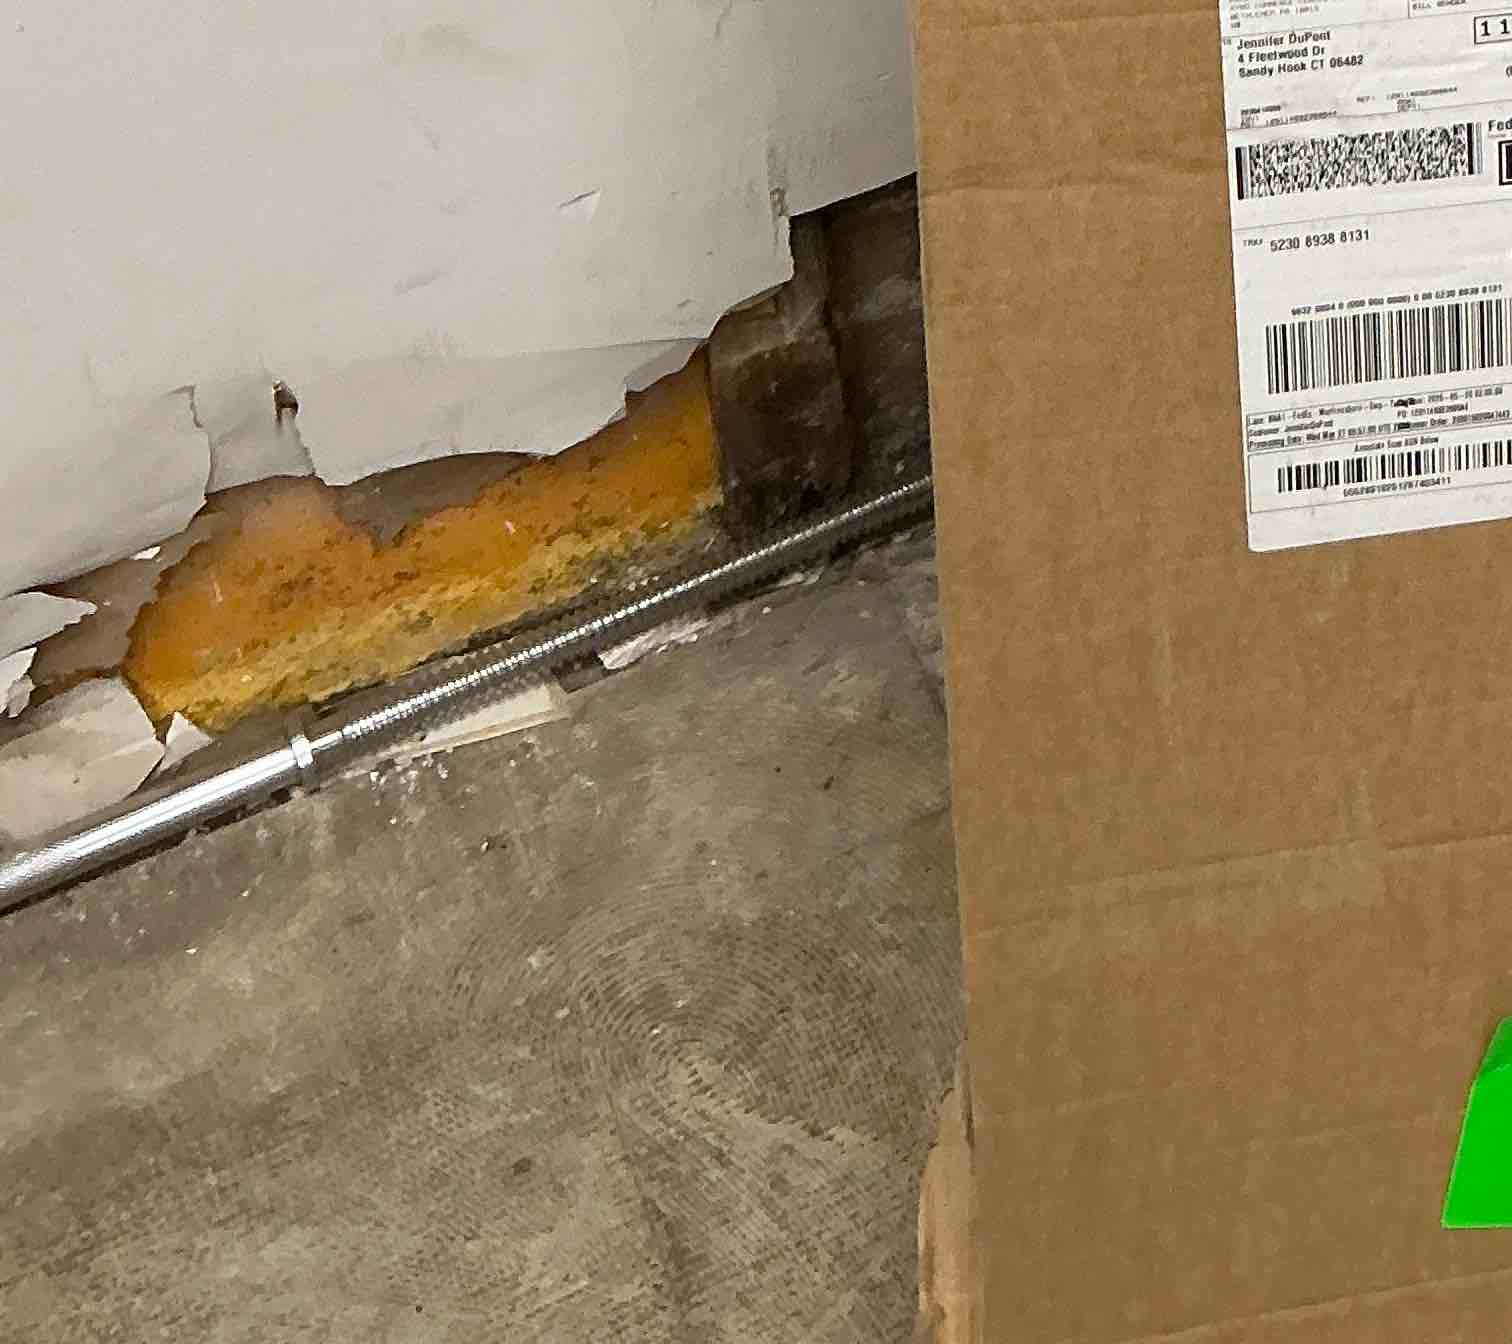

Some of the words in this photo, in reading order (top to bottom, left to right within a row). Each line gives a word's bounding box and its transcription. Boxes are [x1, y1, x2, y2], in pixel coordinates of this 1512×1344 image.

[1237, 36, 1285, 50] Jennifer
[1238, 53, 1245, 63] 4
[1312, 45, 1326, 57] Dr
[1310, 59, 1325, 71] CT
[1269, 236, 1301, 253] 5230
[1304, 232, 1336, 248] 8938
[1339, 228, 1371, 243] 8131
